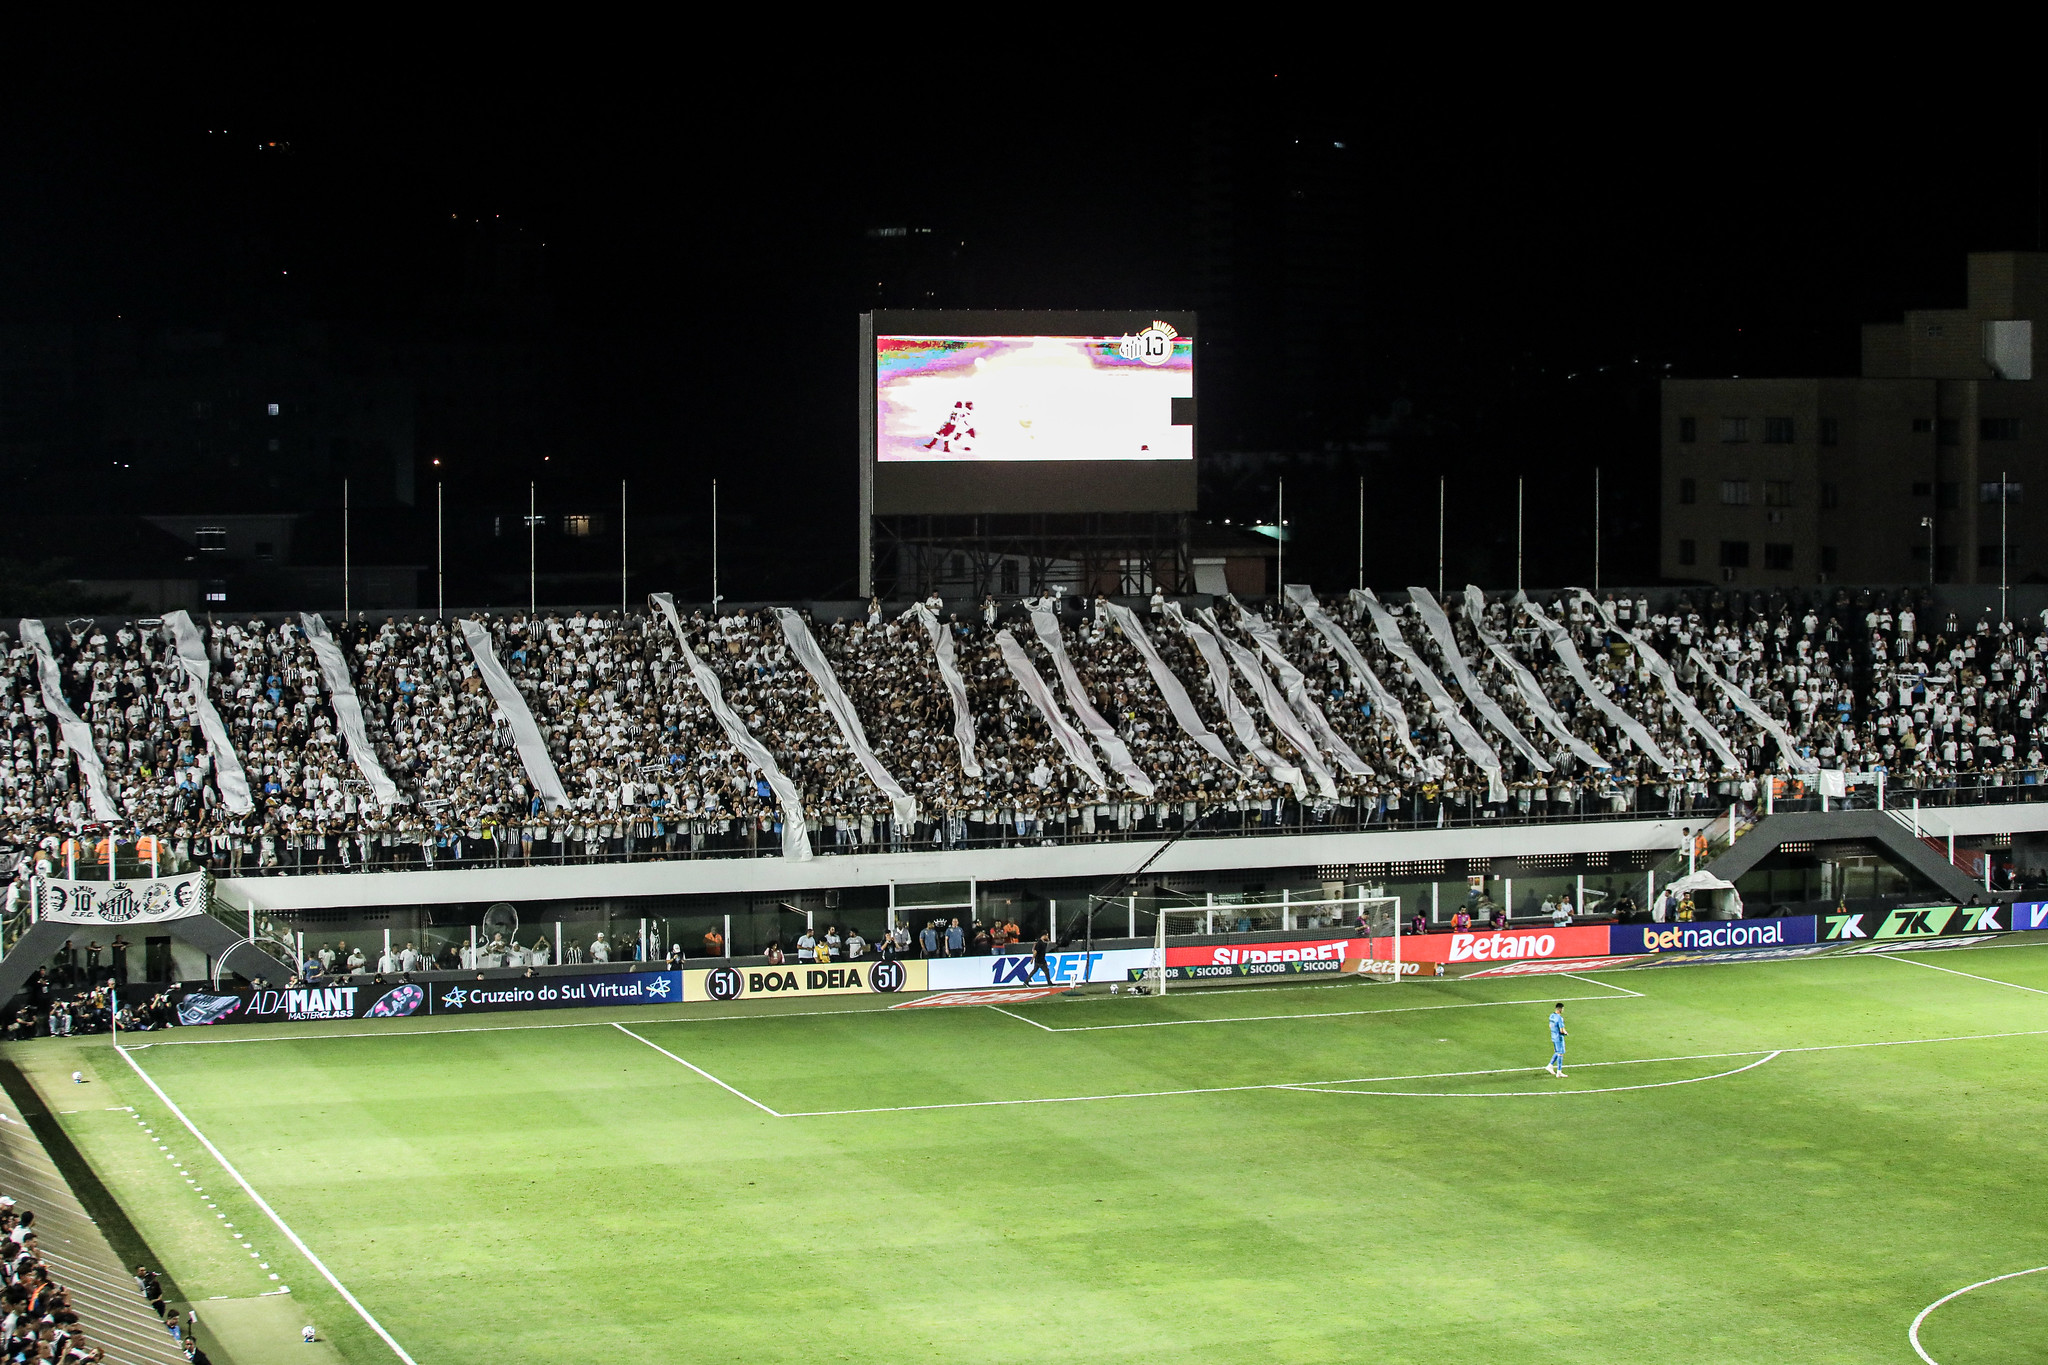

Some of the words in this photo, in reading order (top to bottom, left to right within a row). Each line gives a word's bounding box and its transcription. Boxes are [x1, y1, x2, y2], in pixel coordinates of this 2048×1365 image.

[70, 886, 96, 897] CAMISA
[75, 894, 91, 911] 10
[1826, 914, 1867, 939] 7K
[1895, 911, 1935, 935] 7K
[1962, 906, 2003, 931] 7K
[1448, 933, 1555, 961] Betano
[1643, 921, 1784, 952] betnacional
[877, 964, 897, 988] 51
[1196, 966, 1233, 976] SICOOB
[1250, 963, 1286, 974] SICOOB
[1303, 961, 1339, 971] SICOOB
[1358, 959, 1420, 974] Betano
[470, 986, 534, 1003] Cruzeiro
[538, 985, 558, 1000] do
[561, 983, 586, 999] Sul
[589, 980, 643, 998] Virtual
[715, 971, 735, 996] 51
[750, 972, 799, 992] BOA
[806, 969, 863, 989] IDEIA
[244, 987, 359, 1015] ADAMANT
[288, 1009, 355, 1020] MASTERCLASS
